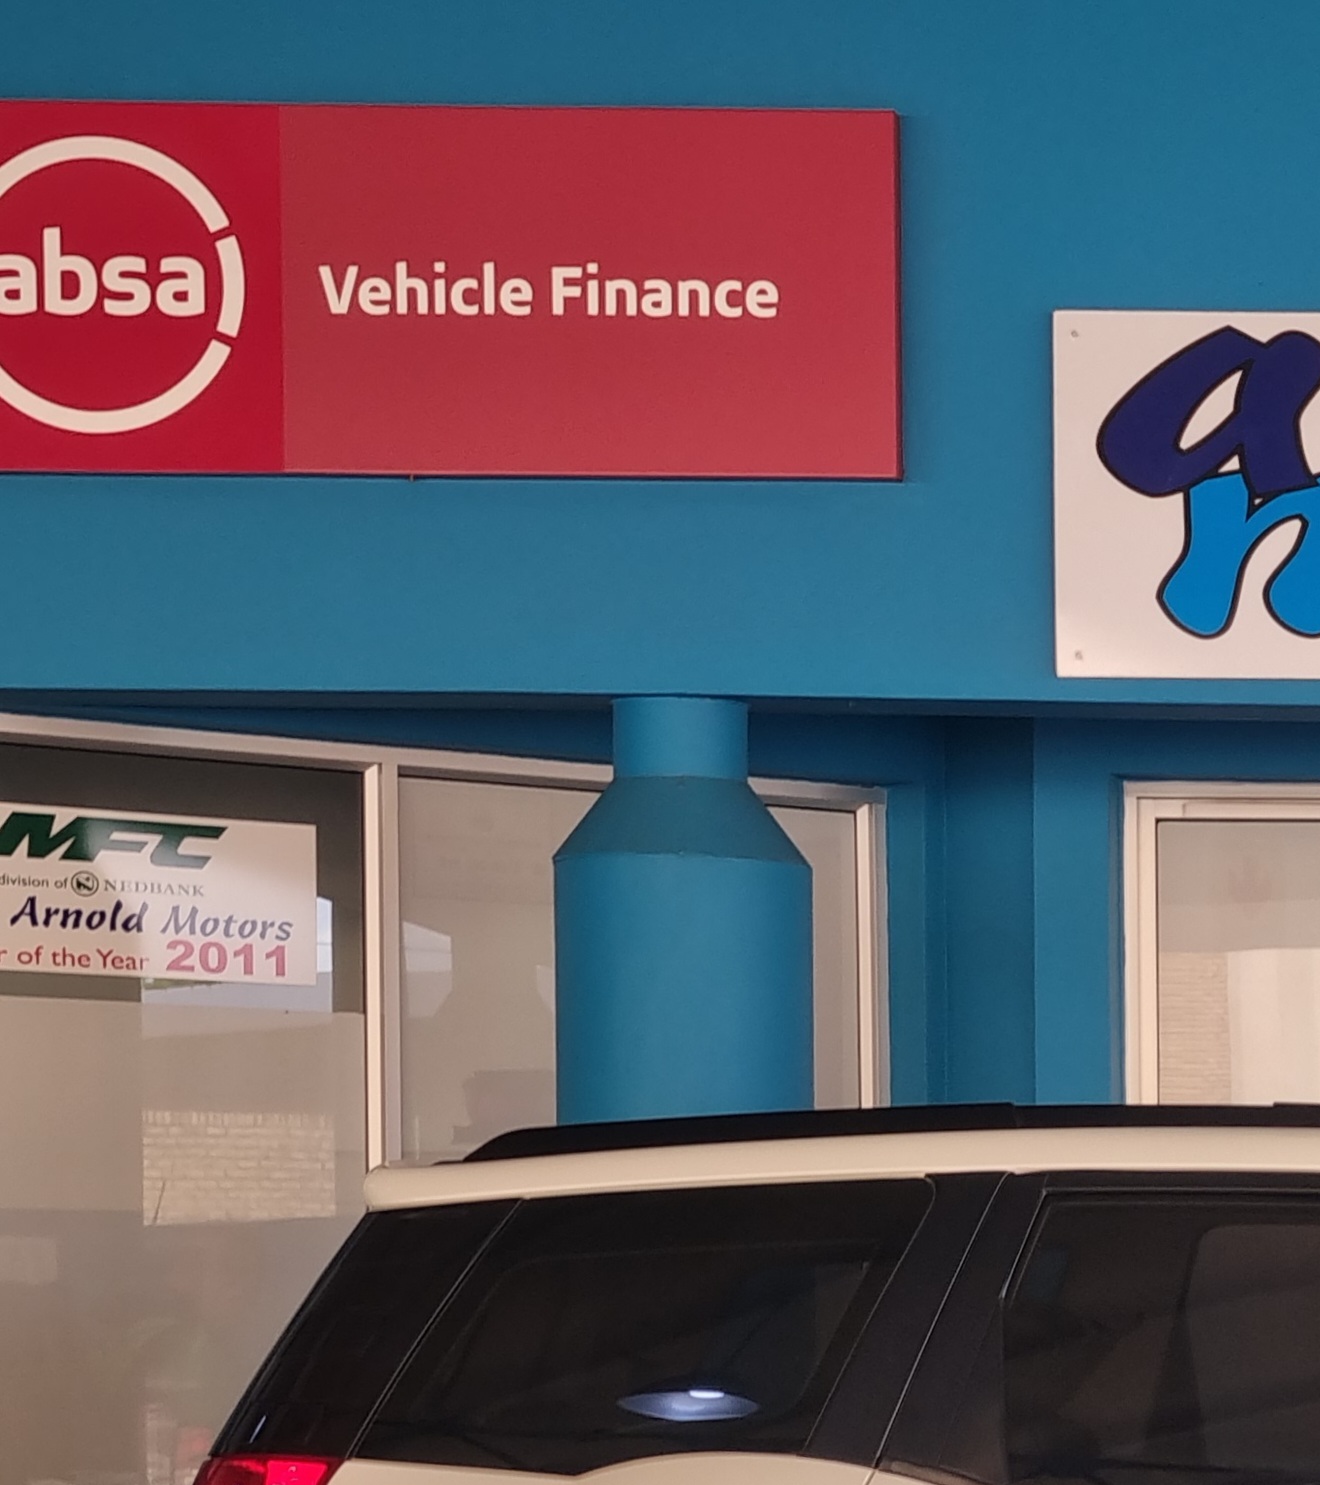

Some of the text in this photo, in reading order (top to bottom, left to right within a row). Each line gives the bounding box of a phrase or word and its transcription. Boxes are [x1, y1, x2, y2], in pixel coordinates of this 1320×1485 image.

[0, 227, 206, 318] absa
[318, 260, 780, 319] Vehicle Finance
[0, 811, 228, 870] MFC
[54, 876, 69, 890] of
[103, 879, 205, 897] NEDBANK
[9, 895, 294, 942] Arnold Motors
[17, 945, 44, 965] of
[52, 946, 91, 968] the
[96, 948, 149, 971] Year
[166, 940, 287, 978] 2011
